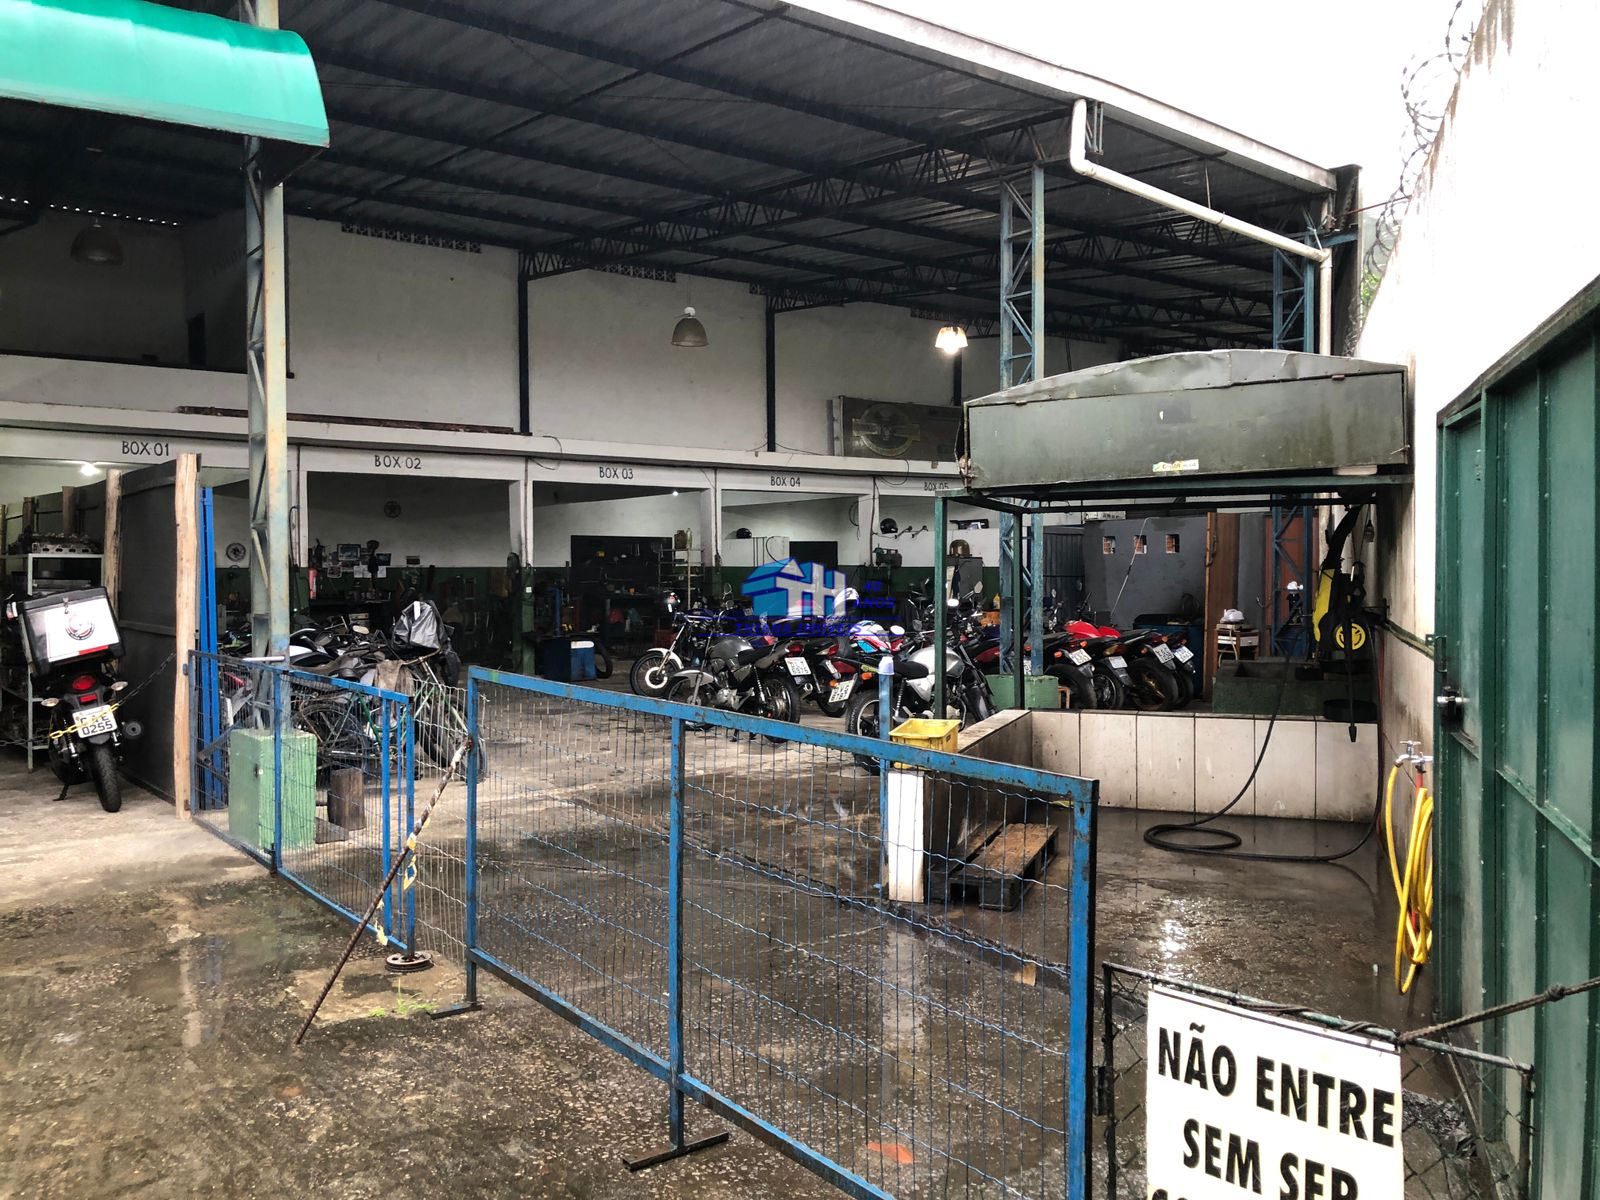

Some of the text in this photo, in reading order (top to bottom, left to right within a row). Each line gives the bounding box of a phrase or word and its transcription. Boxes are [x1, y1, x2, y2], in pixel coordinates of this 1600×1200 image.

[122, 440, 169, 456] BOX 01
[374, 454, 422, 470] BOX 02
[599, 466, 634, 480] BOX 03
[770, 475, 801, 487] BOX 04
[923, 481, 938, 491] BOX
[82, 720, 113, 736] 0255
[1158, 1022, 1395, 1148] NÃO ENTRE
[1183, 1118, 1262, 1195] SEM
